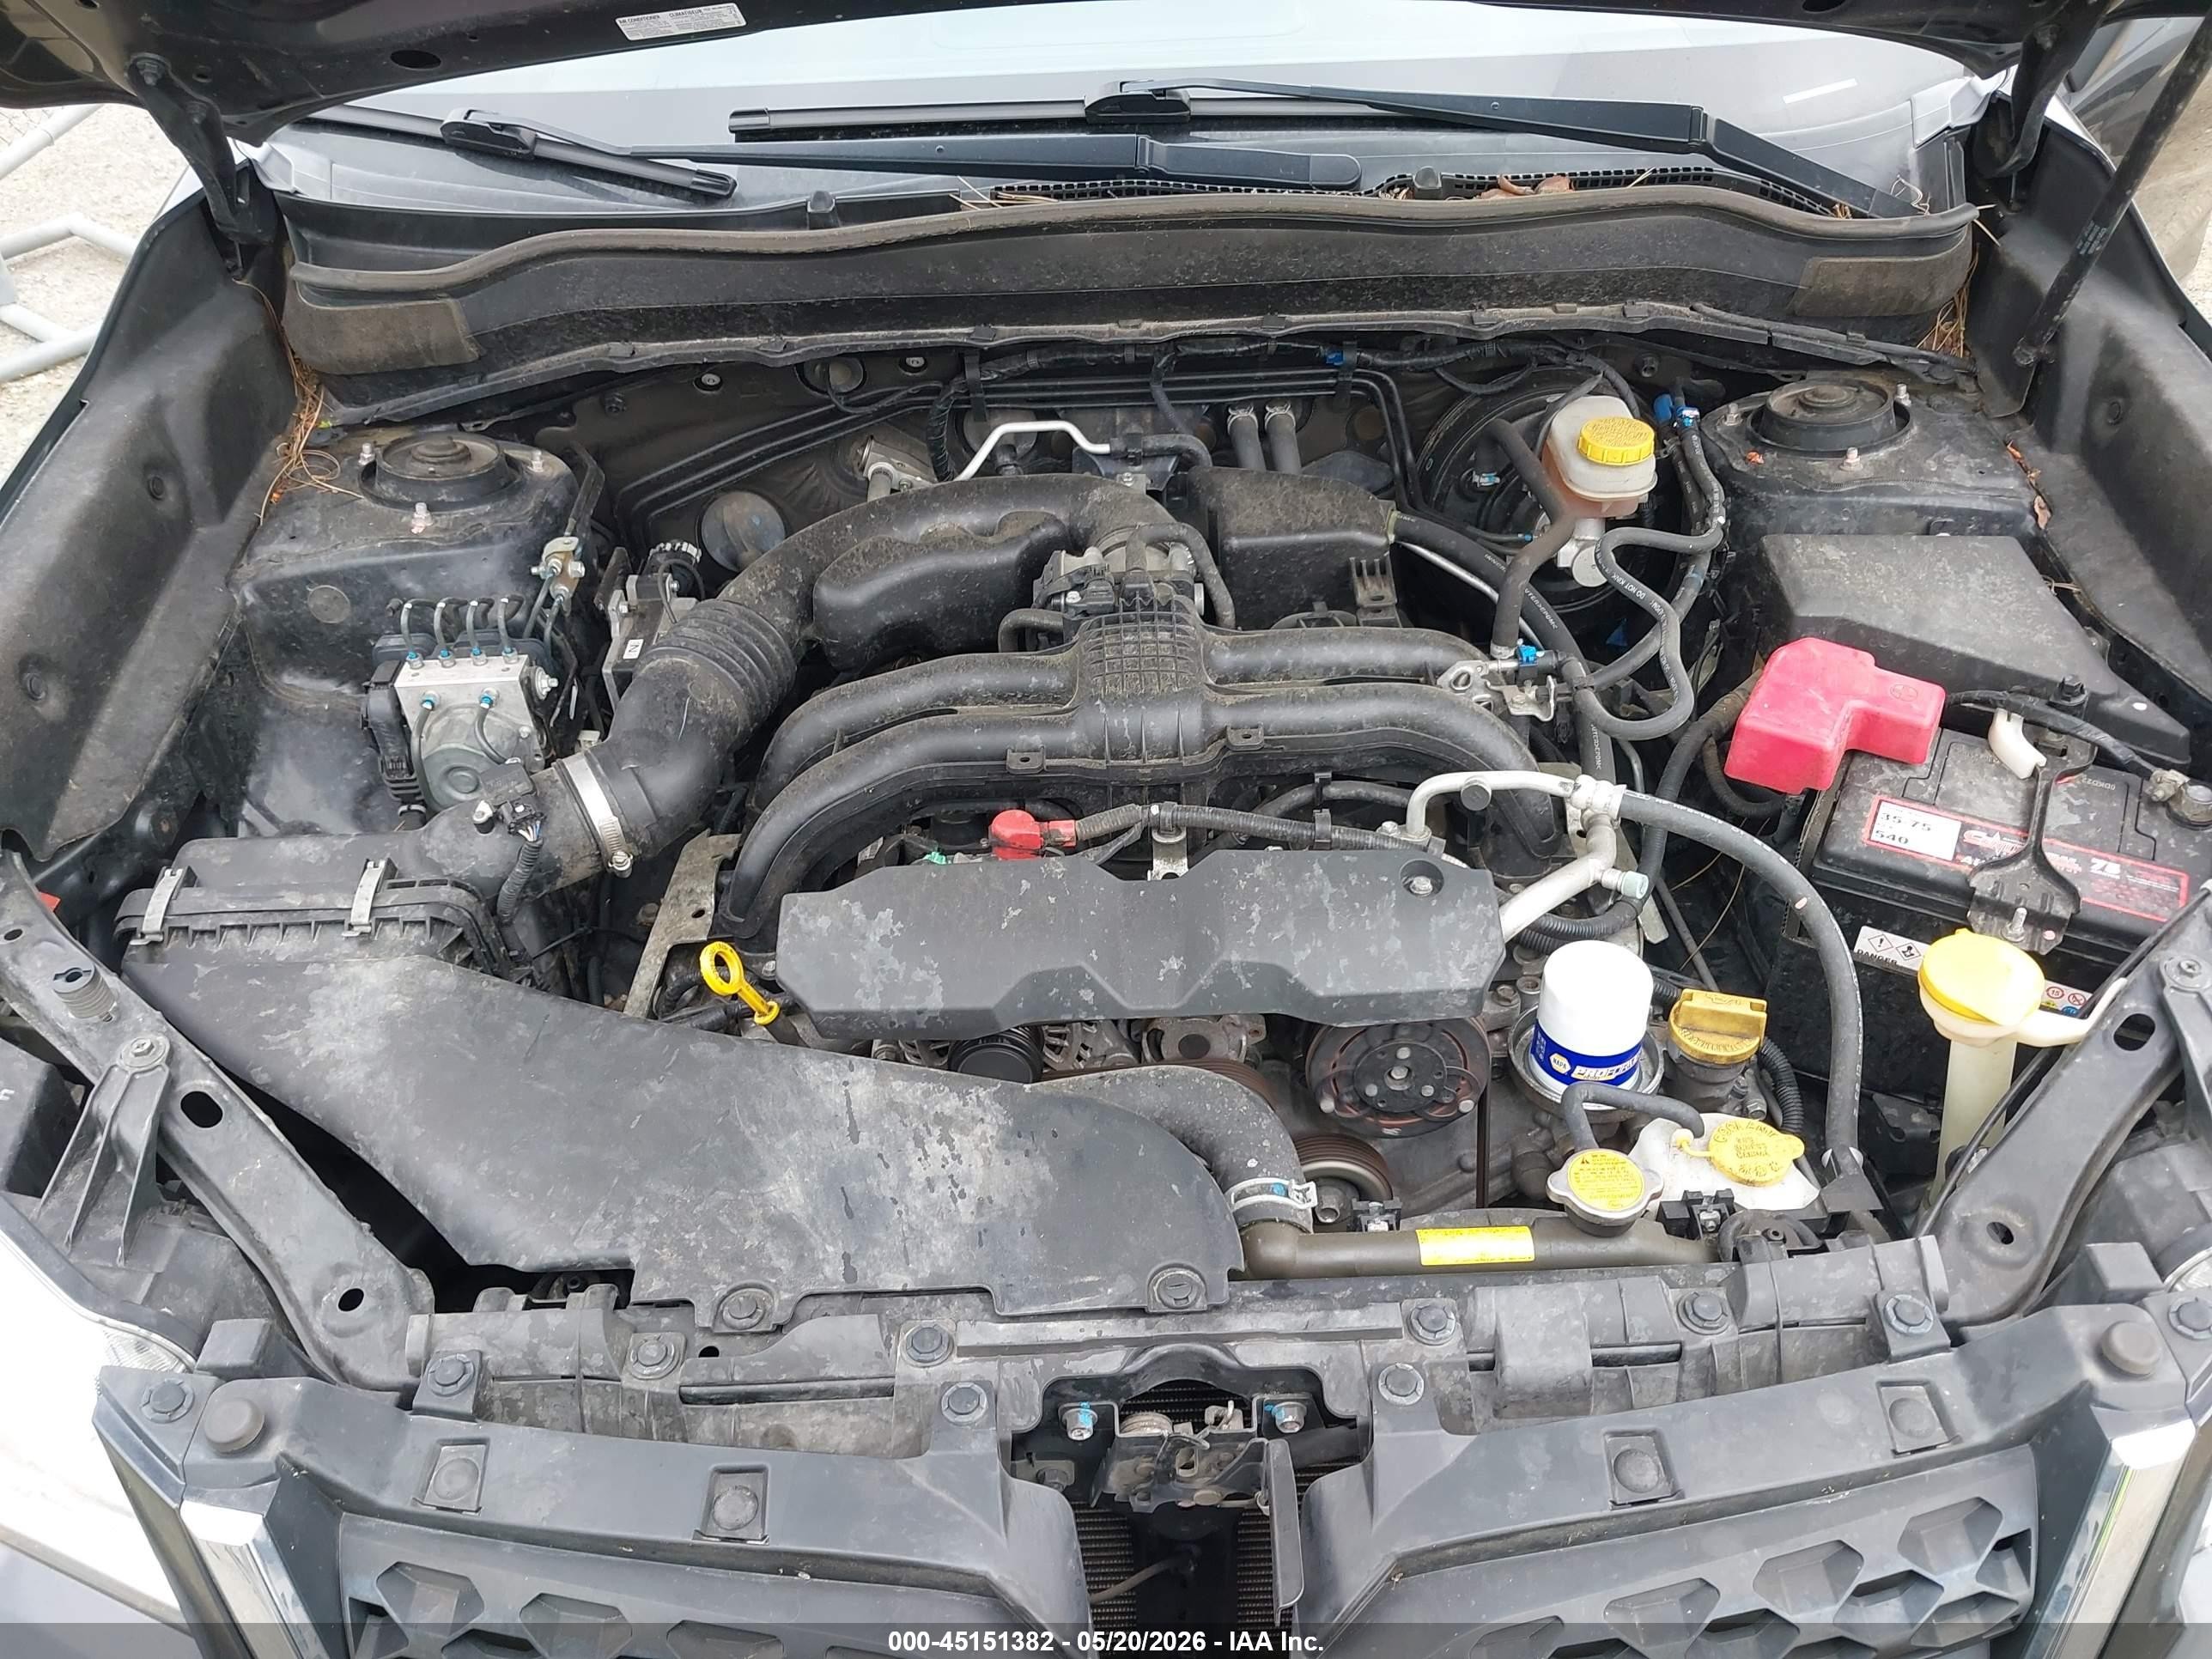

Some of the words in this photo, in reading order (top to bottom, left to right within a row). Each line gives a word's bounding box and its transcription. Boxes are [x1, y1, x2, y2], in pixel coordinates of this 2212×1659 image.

[1626, 580, 1637, 594] NOT
[1636, 590, 1646, 600] DO
[1875, 830, 1909, 845] 540
[1856, 948, 1898, 965] DANGER
[1553, 1057, 1567, 1069] NAPA
